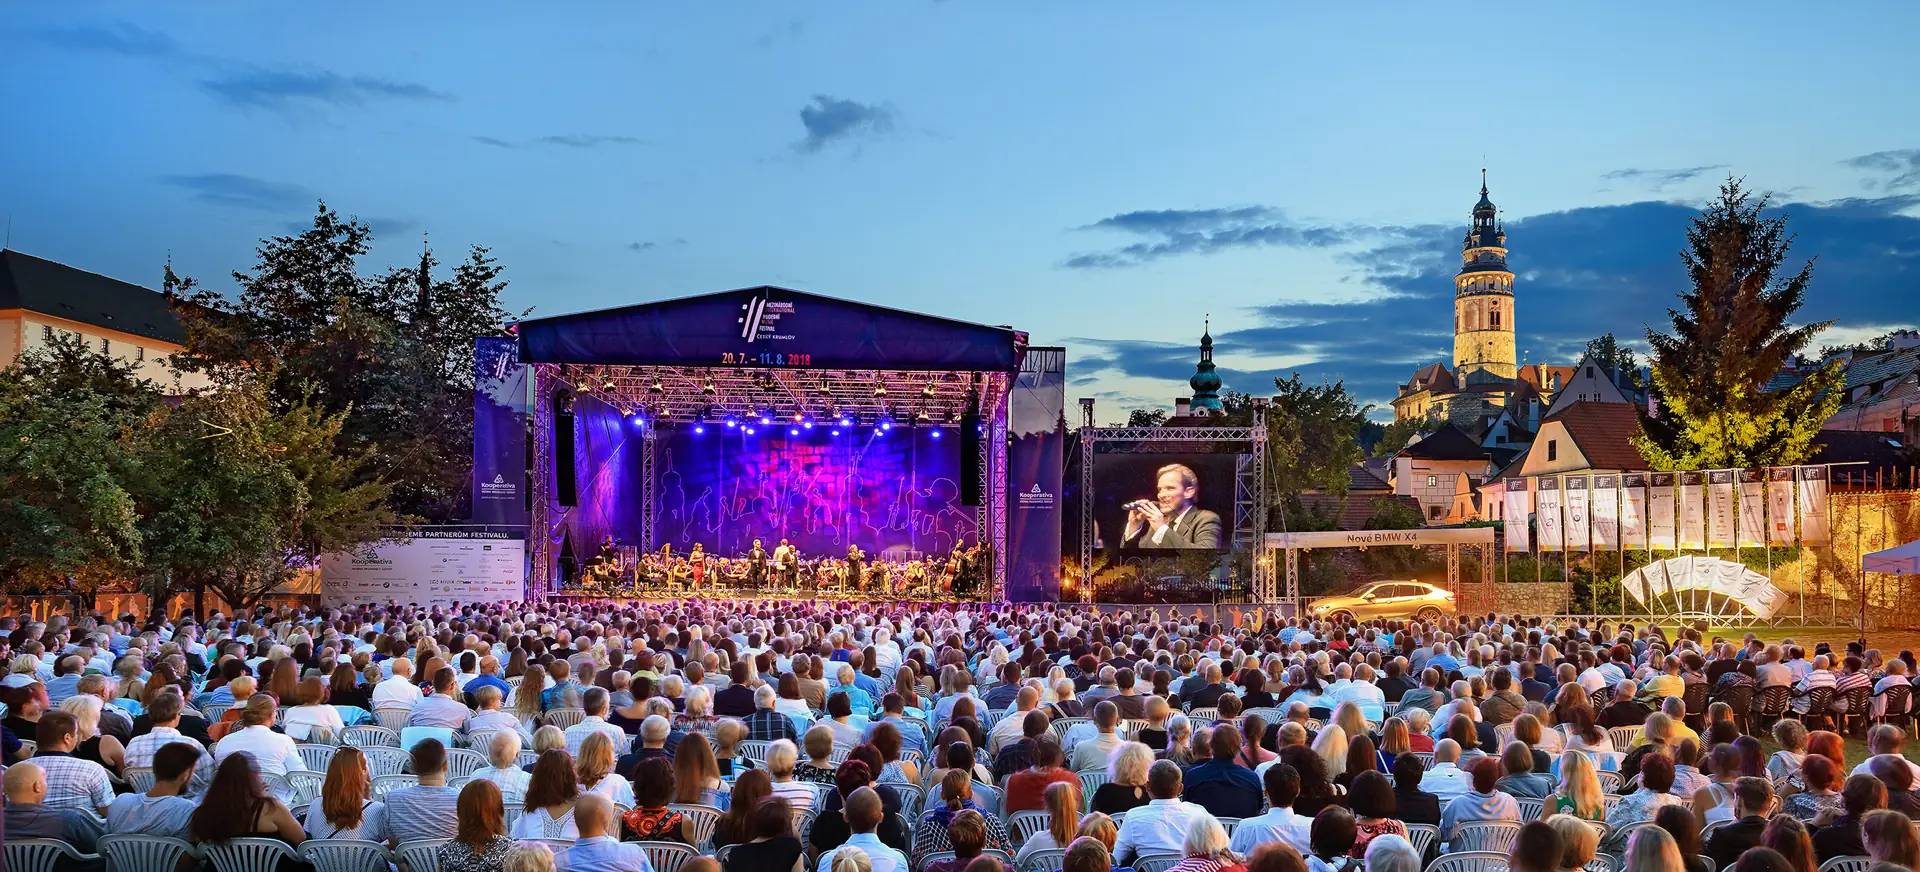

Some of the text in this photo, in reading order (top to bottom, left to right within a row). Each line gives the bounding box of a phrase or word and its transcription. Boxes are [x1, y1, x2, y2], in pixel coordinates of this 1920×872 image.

[722, 352, 736, 364] 20.
[739, 353, 748, 364] 7.
[760, 353, 773, 364] 11.
[776, 353, 785, 364] 8.
[788, 354, 811, 365] 2018
[1347, 532, 1417, 543] Nové BMW X4
